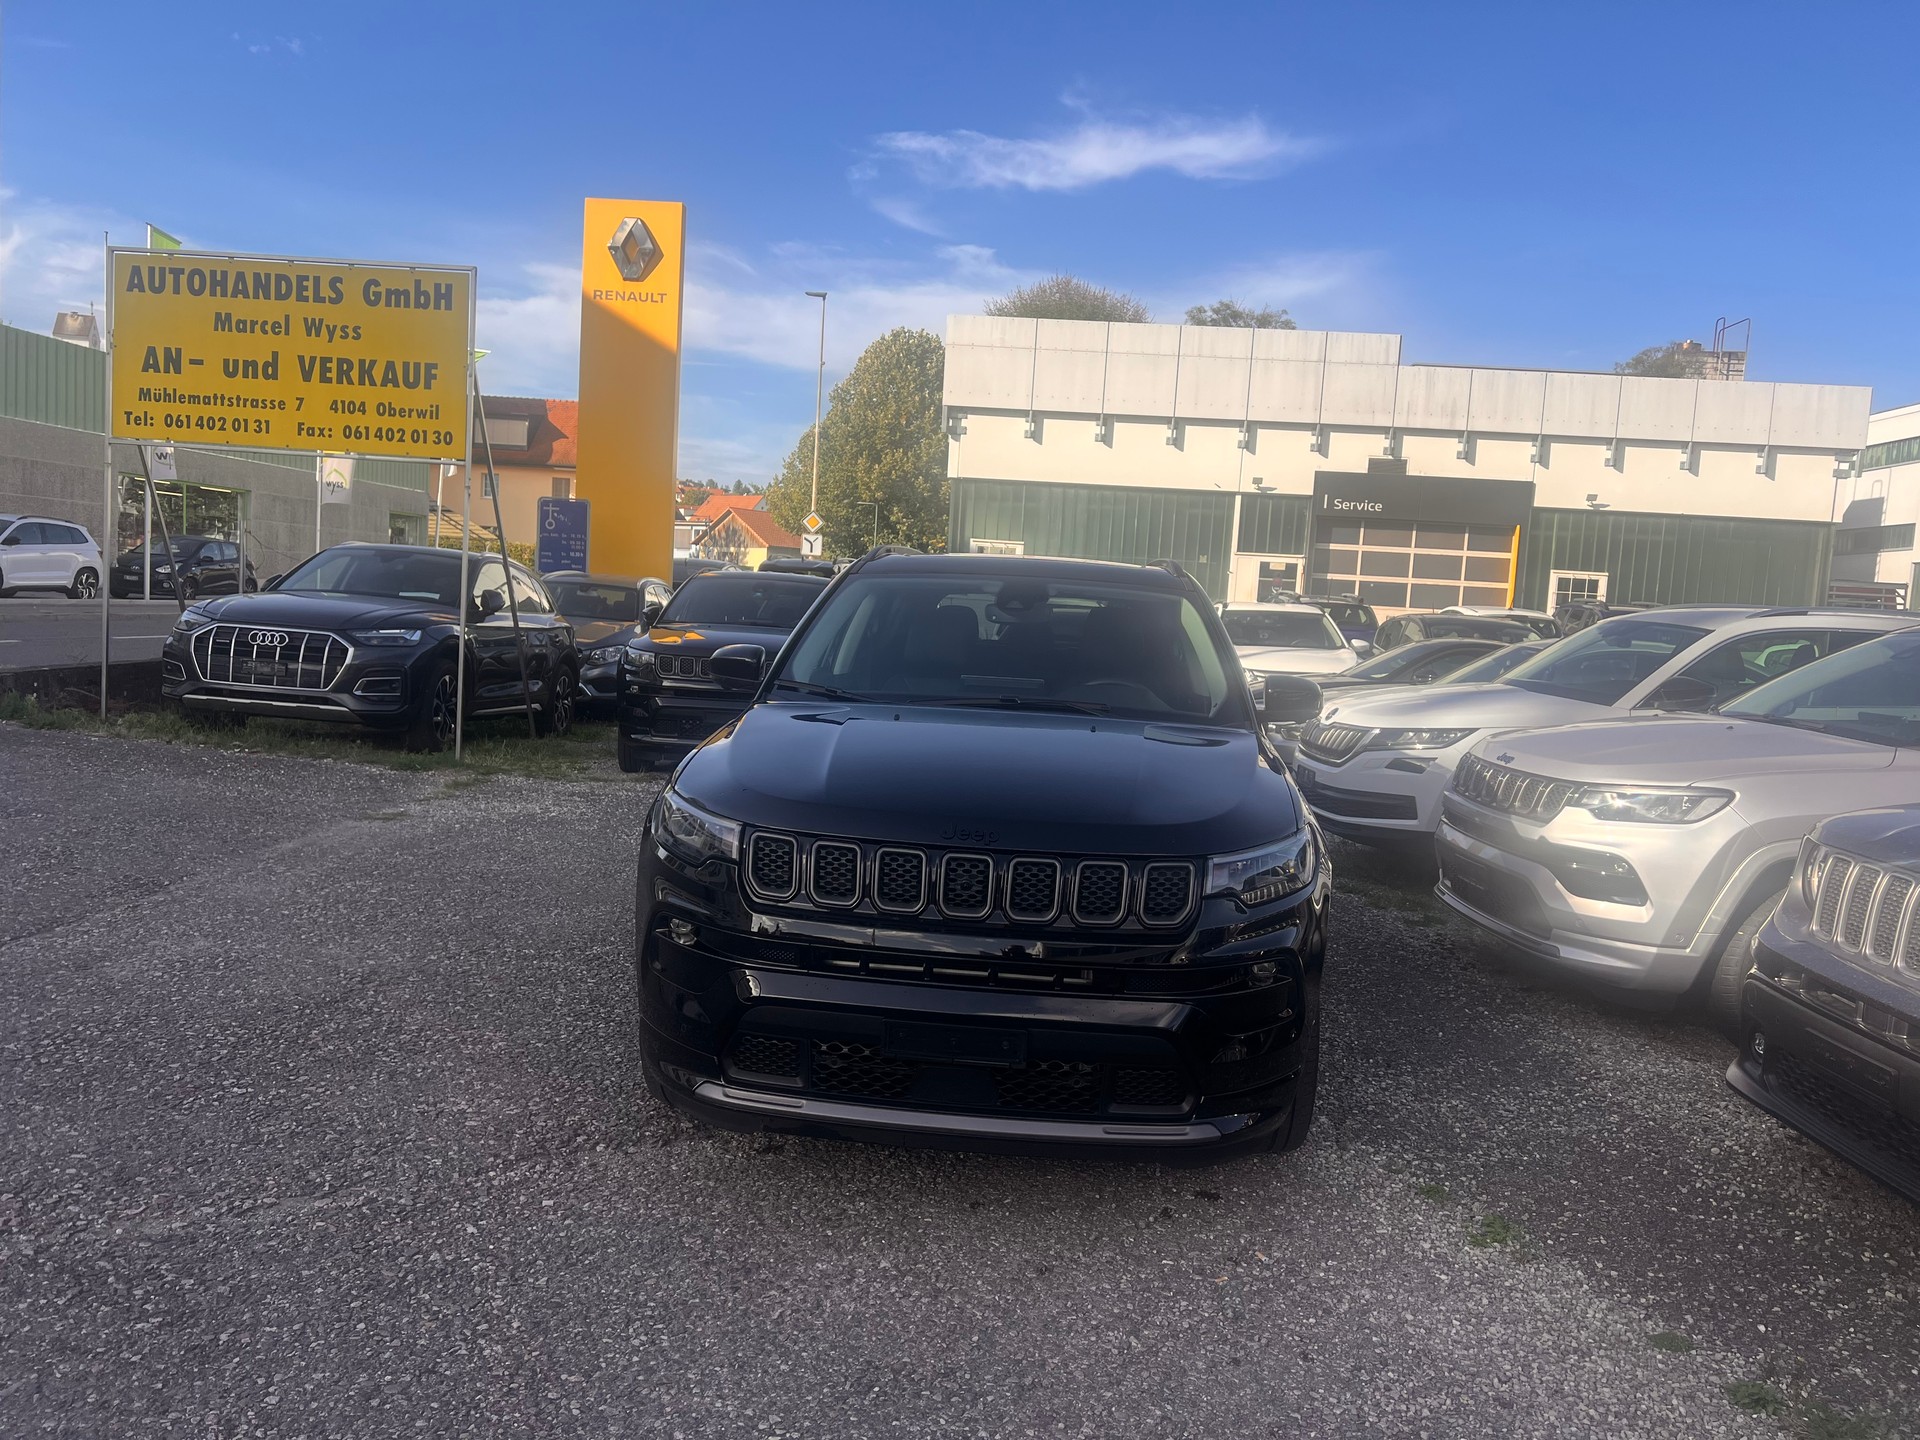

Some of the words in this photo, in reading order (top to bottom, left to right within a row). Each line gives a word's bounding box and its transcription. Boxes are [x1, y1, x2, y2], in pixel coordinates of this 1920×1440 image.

[126, 265, 344, 305] AUTOHANDELS
[362, 278, 453, 312] GmbH
[593, 289, 668, 304] RENAULT
[213, 311, 290, 336] Marcel
[303, 317, 362, 343] Wyss
[222, 351, 279, 381] und
[297, 355, 439, 390] VERKAUF
[138, 387, 286, 411] Mühlemattstrasse
[295, 397, 304, 411] 7
[329, 400, 367, 415] 4104
[376, 402, 440, 420] Oberwil
[124, 411, 155, 427] Tel:
[297, 422, 333, 439] Fax:
[1333, 498, 1383, 512] Service
[941, 823, 1000, 846] Jeep
